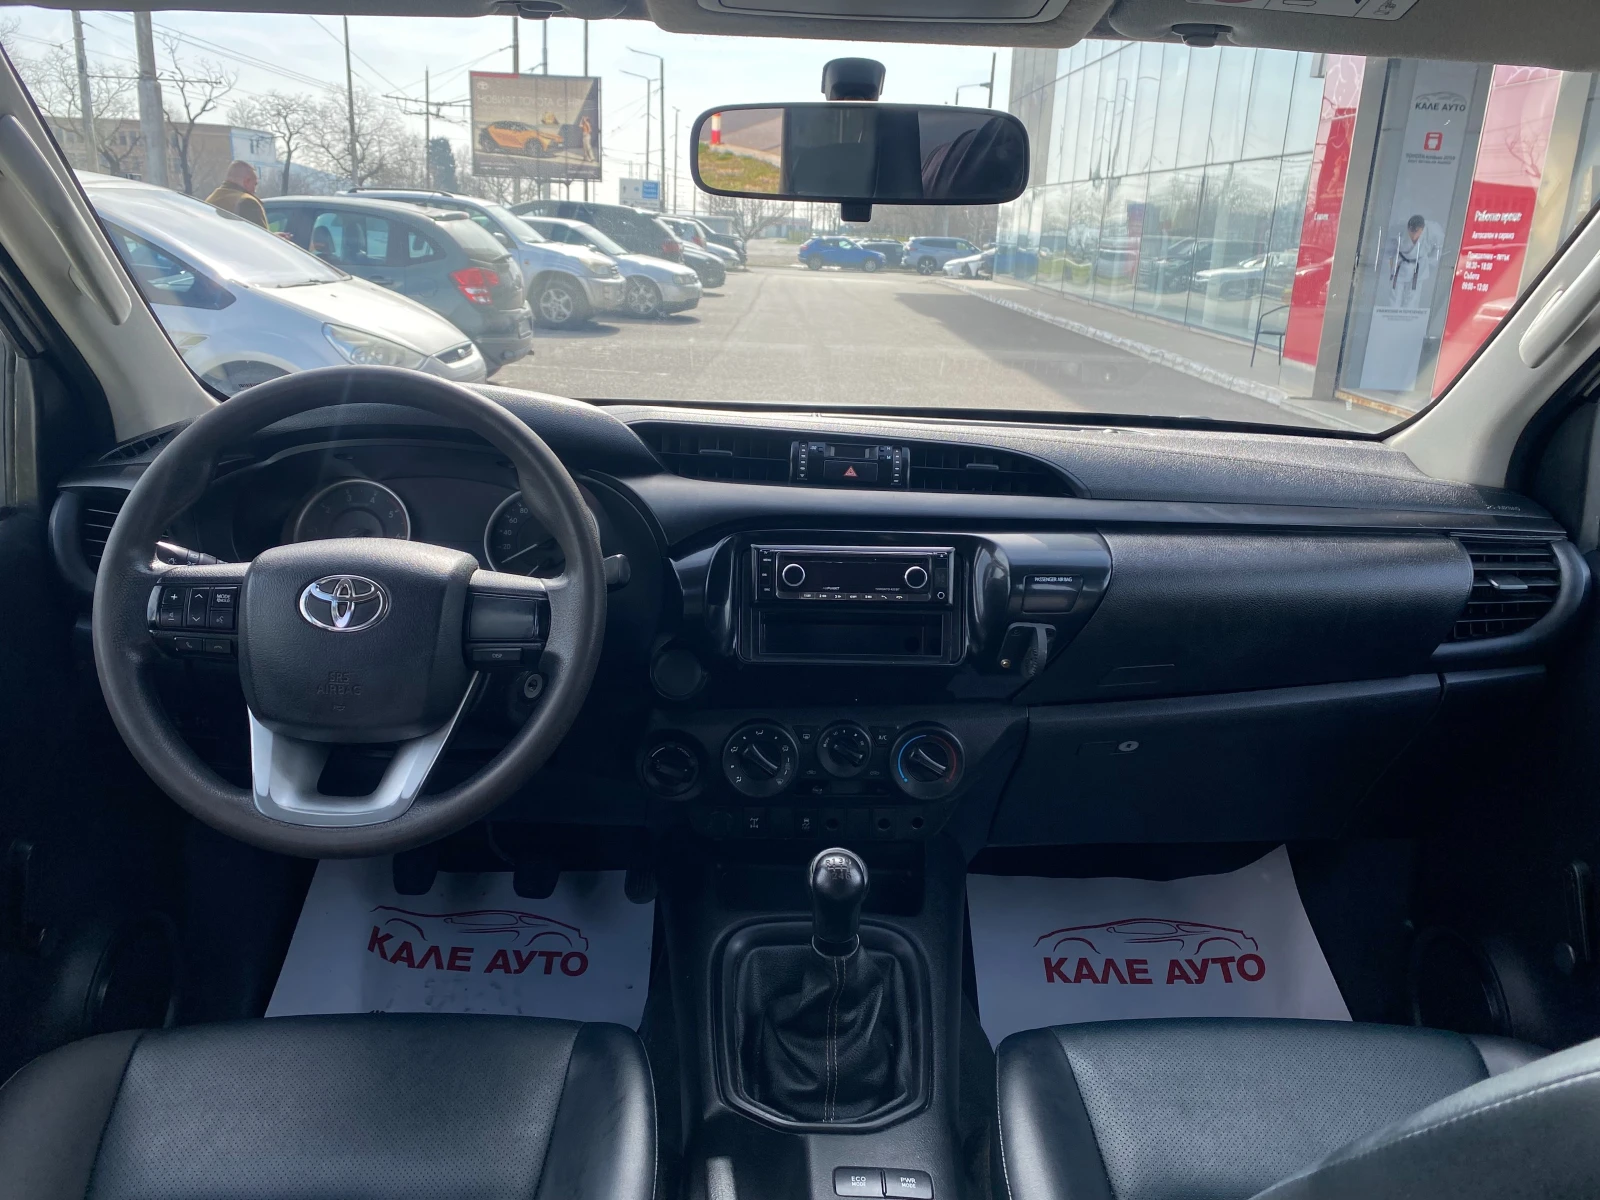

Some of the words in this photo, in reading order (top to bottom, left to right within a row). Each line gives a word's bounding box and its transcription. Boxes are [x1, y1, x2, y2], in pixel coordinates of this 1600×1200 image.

[518, 96, 555, 107] TOYOTA
[1415, 102, 1440, 110] КАЛЕ
[1441, 103, 1466, 112] АУТО
[388, 510, 394, 518] 5
[316, 684, 361, 696] AIRBAG
[367, 925, 475, 972] КАЛЕ
[483, 949, 589, 977] АУТО
[1043, 956, 1154, 985] КАЛЕ
[1166, 953, 1266, 985] АУТО
[900, 1176, 917, 1184] PWR
